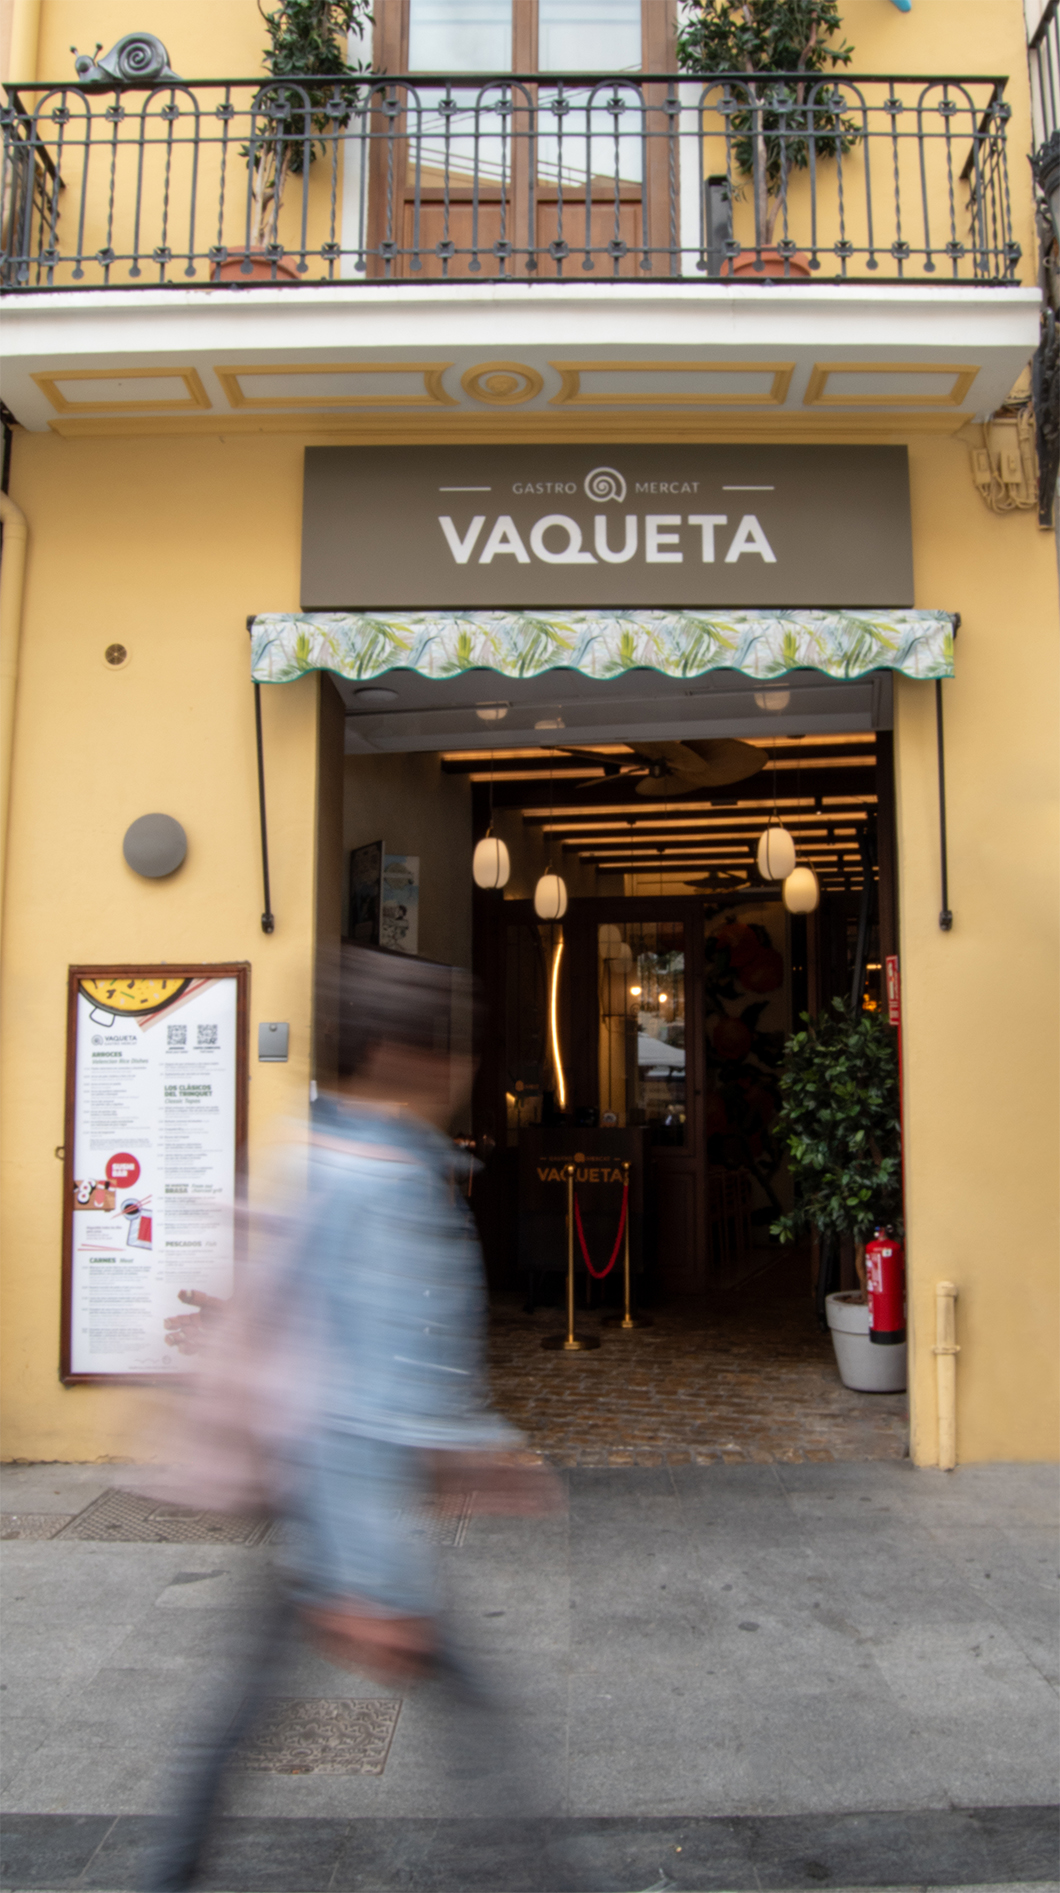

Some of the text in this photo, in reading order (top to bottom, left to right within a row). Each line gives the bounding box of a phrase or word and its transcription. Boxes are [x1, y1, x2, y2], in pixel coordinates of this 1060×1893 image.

[512, 482, 699, 495] GASTRO MERCAT
[438, 514, 777, 565] VAQUETA
[179, 1083, 211, 1091] CLÁSICOS
[112, 1163, 135, 1171] SUSHI
